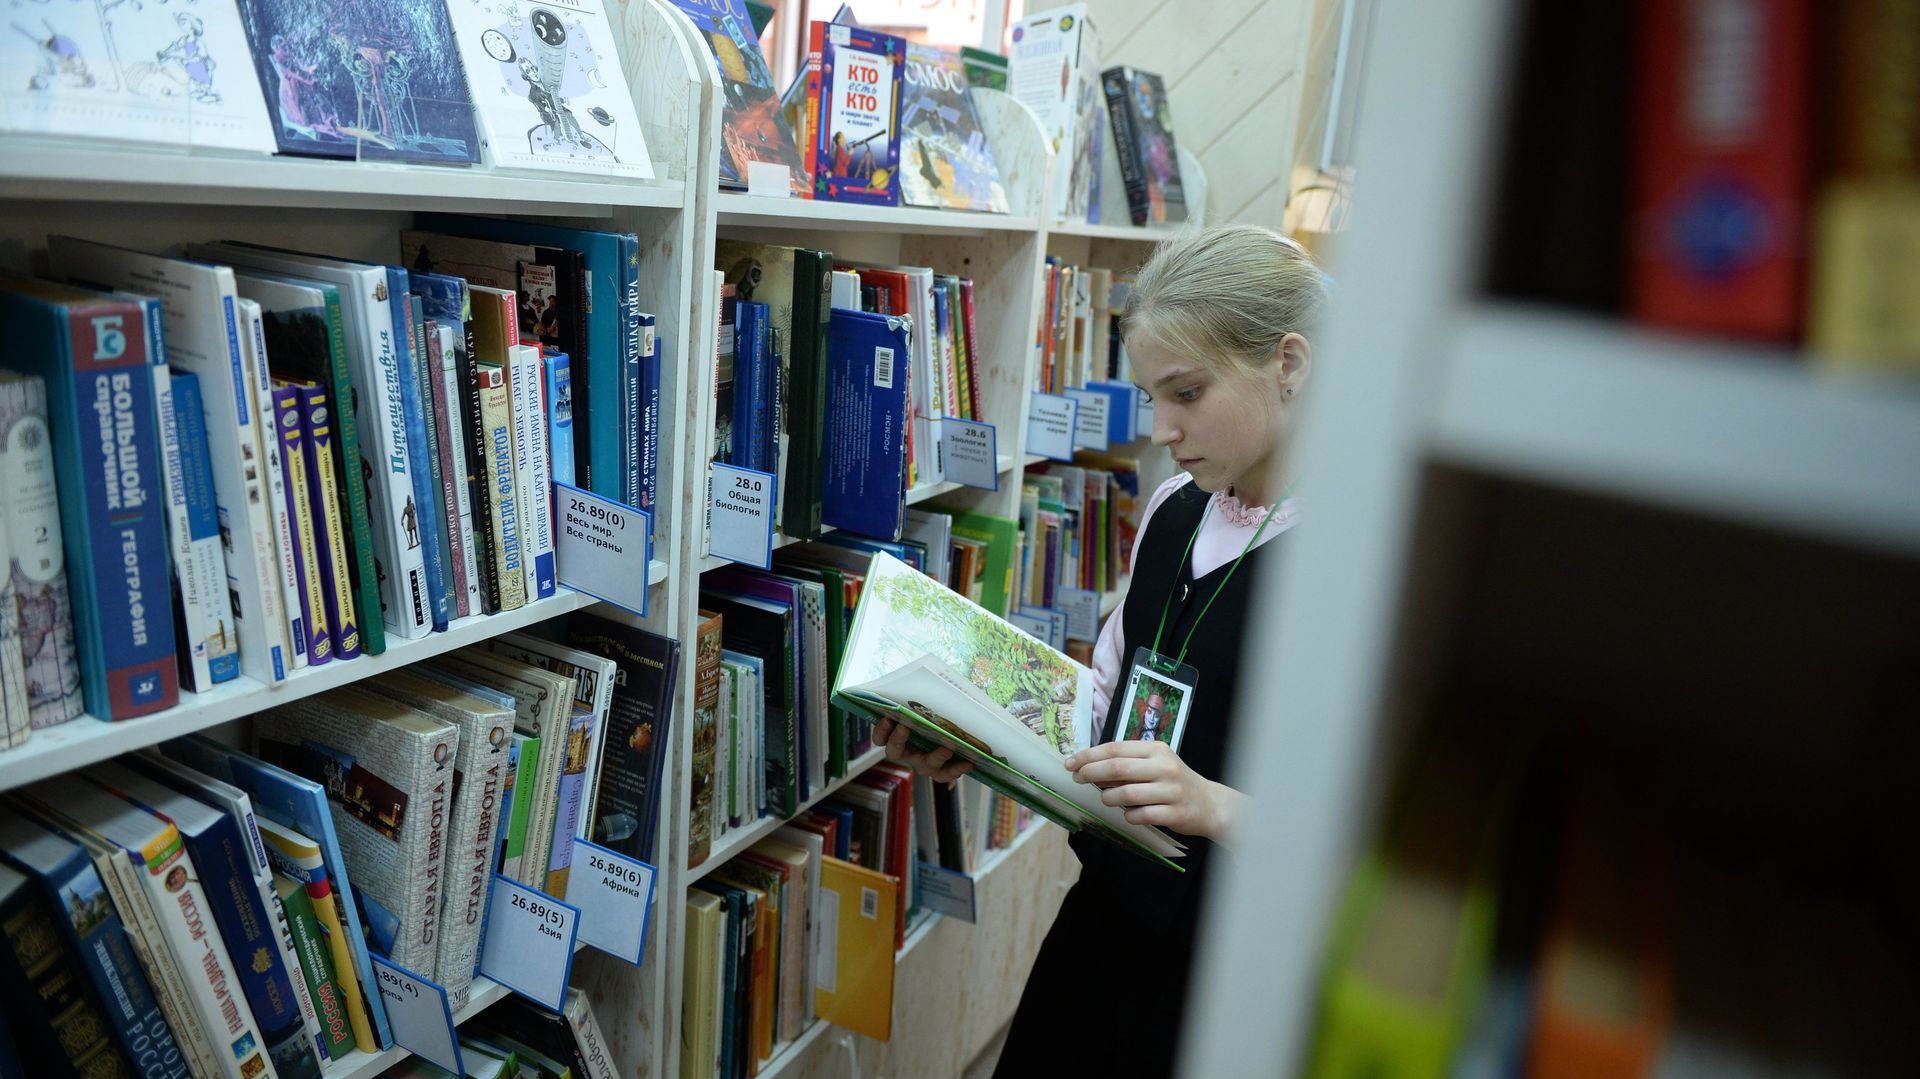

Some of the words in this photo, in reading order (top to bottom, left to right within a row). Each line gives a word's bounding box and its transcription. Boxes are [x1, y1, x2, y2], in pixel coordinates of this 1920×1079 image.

[848, 64, 878, 84] КТО
[848, 82, 877, 95] есть
[904, 61, 964, 94] СМОС
[846, 92, 877, 112] КТО
[629, 280, 638, 315] МИРА
[331, 304, 348, 380] ПРИРОДЫ
[417, 323, 431, 398] ПУТЕШЕСТВЕННИКИ
[629, 320, 638, 364] АТЛАС
[378, 329, 406, 474] Путешествия
[512, 365, 522, 401] ЛУНЫ
[527, 364, 538, 411] РУССКИЕ
[159, 389, 179, 446] БЕРИНГА
[773, 366, 782, 444] Подзеркалье
[93, 374, 122, 510] справочник
[112, 373, 147, 508] БОЛЬШОЙ
[425, 401, 437, 450] ЗНАМЕНИТЫЕ
[516, 417, 526, 470] ЧЕЛОВЕК
[530, 414, 540, 451] ИМЕНА
[951, 435, 987, 448] Зоология
[965, 428, 987, 439] 28.6
[166, 450, 186, 507] РЕВИЗИЯ
[294, 456, 304, 483] ТАЙНЫ
[323, 452, 332, 479] ТАЙНЫ
[431, 454, 440, 479] САМЫЕ
[467, 332, 477, 386] ЧУДЕСА
[472, 391, 484, 456] ПРИРОДЫ
[480, 469, 490, 515] ДЕТСКАЯ
[486, 521, 498, 604] ЭНЦИКЛОПЕДИЯ
[493, 426, 512, 495] ФРЕГАТОВ
[534, 455, 543, 470] НА
[298, 484, 308, 519] ВЕЛИКИХ
[327, 480, 336, 514] ВЕЛИКИХ
[445, 482, 455, 510] ПОЛО
[534, 473, 546, 504] КАРТЕ
[728, 490, 761, 505] Общая
[735, 477, 762, 492] 28.0
[522, 485, 531, 535] Чумаченко
[535, 506, 548, 549] ЕВРАЗИИ
[567, 513, 590, 529] Весь
[592, 523, 615, 538] мир.
[570, 499, 625, 530] 26.89(0)
[715, 500, 760, 517] биология
[34, 526, 48, 544] 2
[280, 512, 290, 551] КОЛУМБЫ
[330, 515, 345, 580] ГЕОГРАФИЧЕСКИХ
[448, 514, 458, 550] МАРКО
[499, 498, 520, 571] ВОДИТЕЛИ
[567, 526, 584, 540] Все
[586, 534, 623, 554] страны
[286, 553, 295, 587] РУССКИЕ
[302, 520, 317, 585] ГЕОГРАФИЧЕСКИХ
[466, 545, 475, 577] Томилин
[121, 529, 148, 646] ГЕОГРАФИЯ
[183, 558, 198, 605] Николай
[341, 581, 352, 618] ОТКРЫТИЙ
[411, 574, 423, 622] ПОЛНАЯ
[417, 566, 430, 623] ЭНЦИКЛОПЕДИЯ
[312, 586, 323, 625] ОТКРЫТИЙ
[427, 780, 445, 861] ЕВРОПА
[466, 848, 486, 925] СТАРАЯ
[476, 763, 499, 842] ЕВРОПА
[589, 855, 642, 886] 26.89(6)
[601, 877, 641, 899] Африка
[177, 889, 207, 942] РОССИЯ
[422, 864, 439, 944] СТАРАЯ
[511, 893, 565, 928] 26.89(5)
[295, 914, 321, 984] ЭНЦИКЛОПЕДИЧЕСКИЙ
[538, 924, 562, 941] Азия
[202, 952, 231, 999] РОДИНА
[311, 938, 328, 979] СПРАВОЧНИК
[93, 939, 136, 1020] ЭНЦИКЛОПЕДИЯ
[293, 967, 305, 992] КОЛЬЦО
[374, 968, 419, 998] .89(4)
[379, 985, 404, 1003] ропа
[219, 997, 244, 1036] НАША
[302, 994, 315, 1020] ЗОЛОТОЕ
[317, 981, 347, 1044] РОССИЯ
[143, 1007, 187, 1079] ГОРОД
[582, 1020, 614, 1079] еловек
